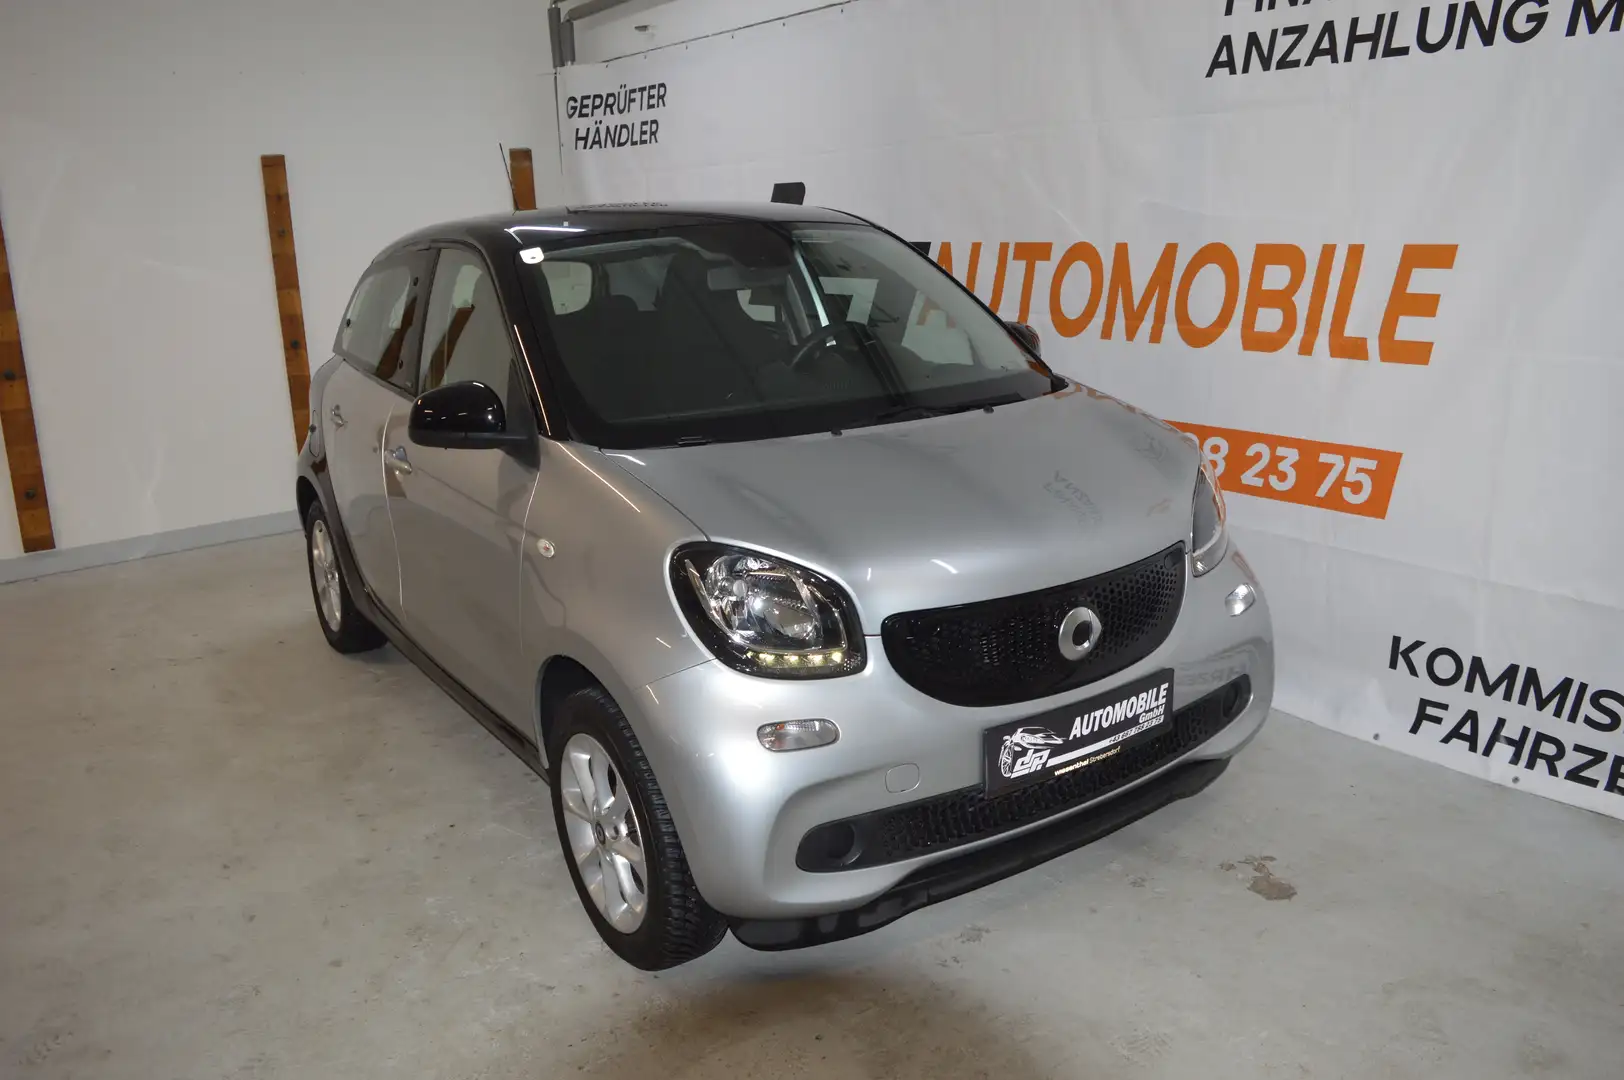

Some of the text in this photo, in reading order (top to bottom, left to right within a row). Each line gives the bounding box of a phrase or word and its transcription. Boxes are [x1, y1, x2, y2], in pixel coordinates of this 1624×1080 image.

[1205, 0, 1549, 78] ANZAHLUNG
[566, 82, 667, 119] GEPRÜFTER
[574, 119, 659, 150] HÄNDLER
[1240, 443, 1300, 491] 23
[1315, 453, 1378, 505] 75
[1069, 682, 1169, 741] AUTOMOBILE
[1138, 704, 1165, 724] GmbH
